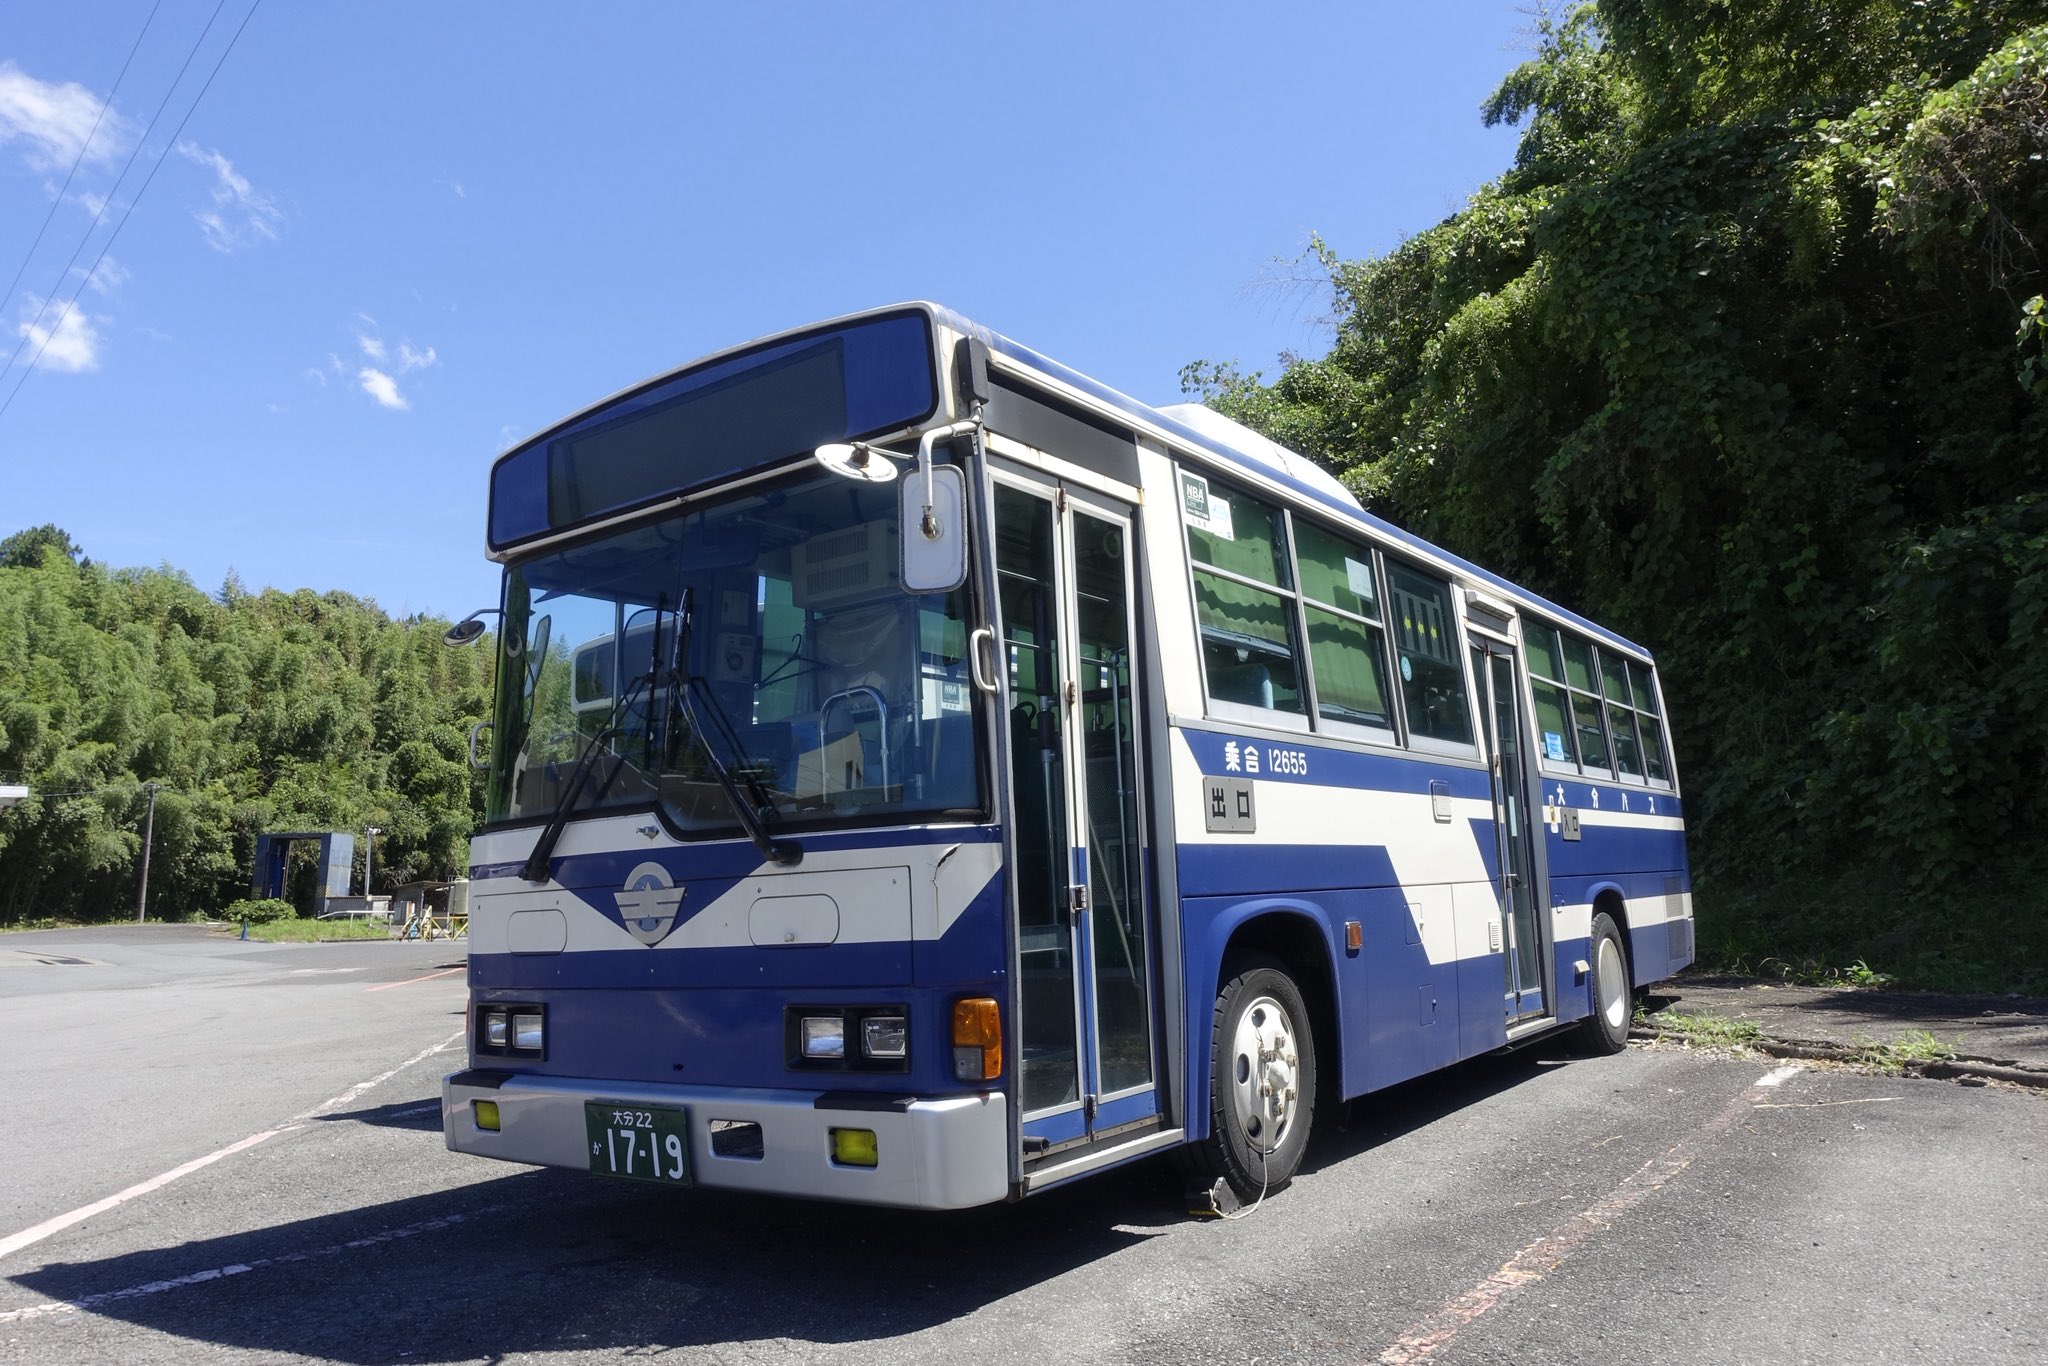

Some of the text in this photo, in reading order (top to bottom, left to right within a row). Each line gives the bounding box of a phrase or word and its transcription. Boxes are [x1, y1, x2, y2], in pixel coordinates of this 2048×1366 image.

[1186, 483, 1205, 503] NBA
[1225, 741, 1307, 775] 乗合 12655
[1212, 787, 1250, 819] 出口
[592, 1141, 602, 1156] か
